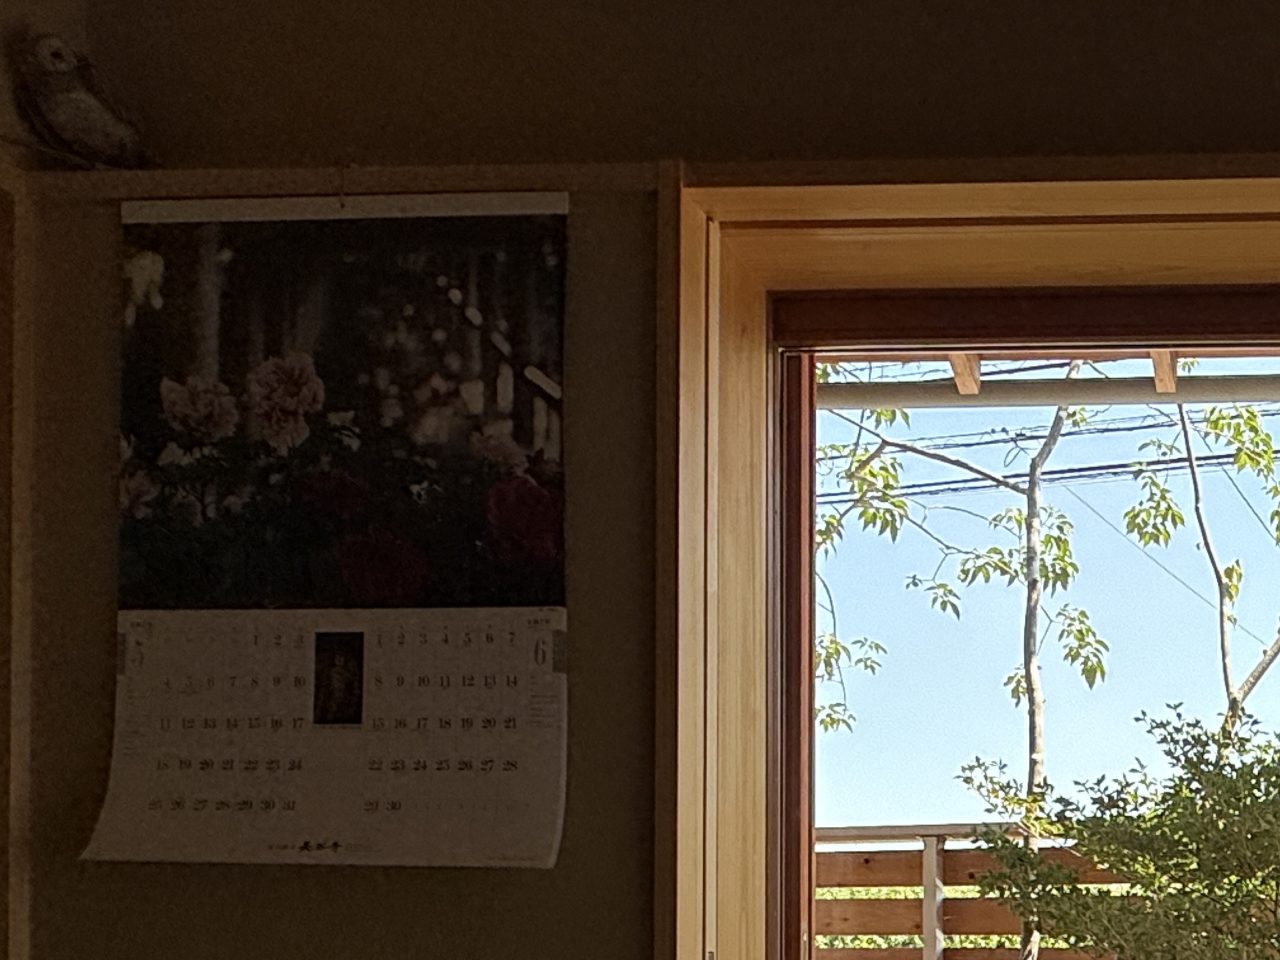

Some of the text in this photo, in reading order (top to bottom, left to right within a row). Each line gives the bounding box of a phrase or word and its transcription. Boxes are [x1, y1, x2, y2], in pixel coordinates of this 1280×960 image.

[253, 634, 259, 646] 1
[273, 634, 282, 646] 2
[397, 632, 406, 645] 2
[419, 632, 428, 645] 3
[441, 632, 450, 645] 4
[463, 631, 472, 645] 5
[485, 632, 494, 644] 6
[507, 631, 516, 644] 7
[534, 638, 547, 666] 6
[206, 676, 215, 688] 6
[229, 676, 237, 688] 7
[250, 676, 259, 688] 8
[272, 676, 281, 688] 9
[293, 676, 306, 688] 10
[374, 674, 518, 687] 8 9 10 11 12 13 14
[160, 717, 305, 730] 11 12 13 14 15 16 17
[372, 716, 517, 729] 15 16 17 18 19 20 21
[156, 758, 302, 771] 18 19 20 21 22 23 24
[368, 759, 518, 771] 22 23 24 25 26 27 28
[193, 799, 208, 811] 27
[215, 799, 231, 811] 28
[236, 799, 253, 811] 29
[259, 799, 276, 811] 30
[282, 799, 296, 811] 31
[364, 800, 379, 812] 29
[385, 800, 402, 812] 30
